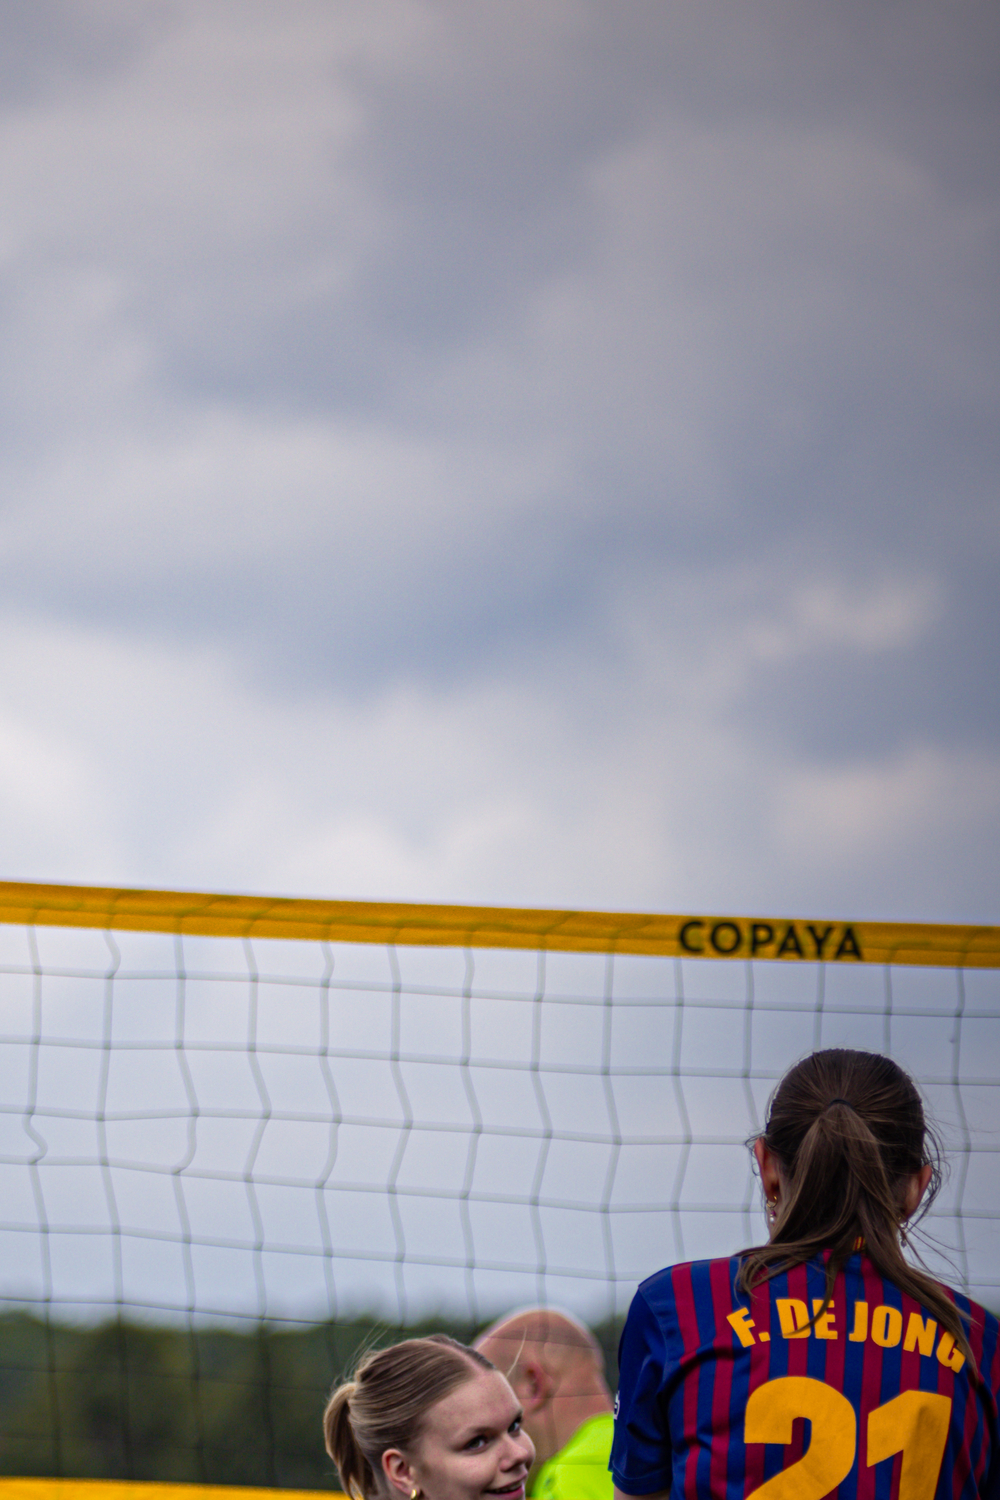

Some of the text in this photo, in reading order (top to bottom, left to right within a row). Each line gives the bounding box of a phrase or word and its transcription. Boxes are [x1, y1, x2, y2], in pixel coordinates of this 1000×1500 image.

[679, 921, 863, 960] COPAYA
[726, 1299, 966, 1373] F. DE JONG
